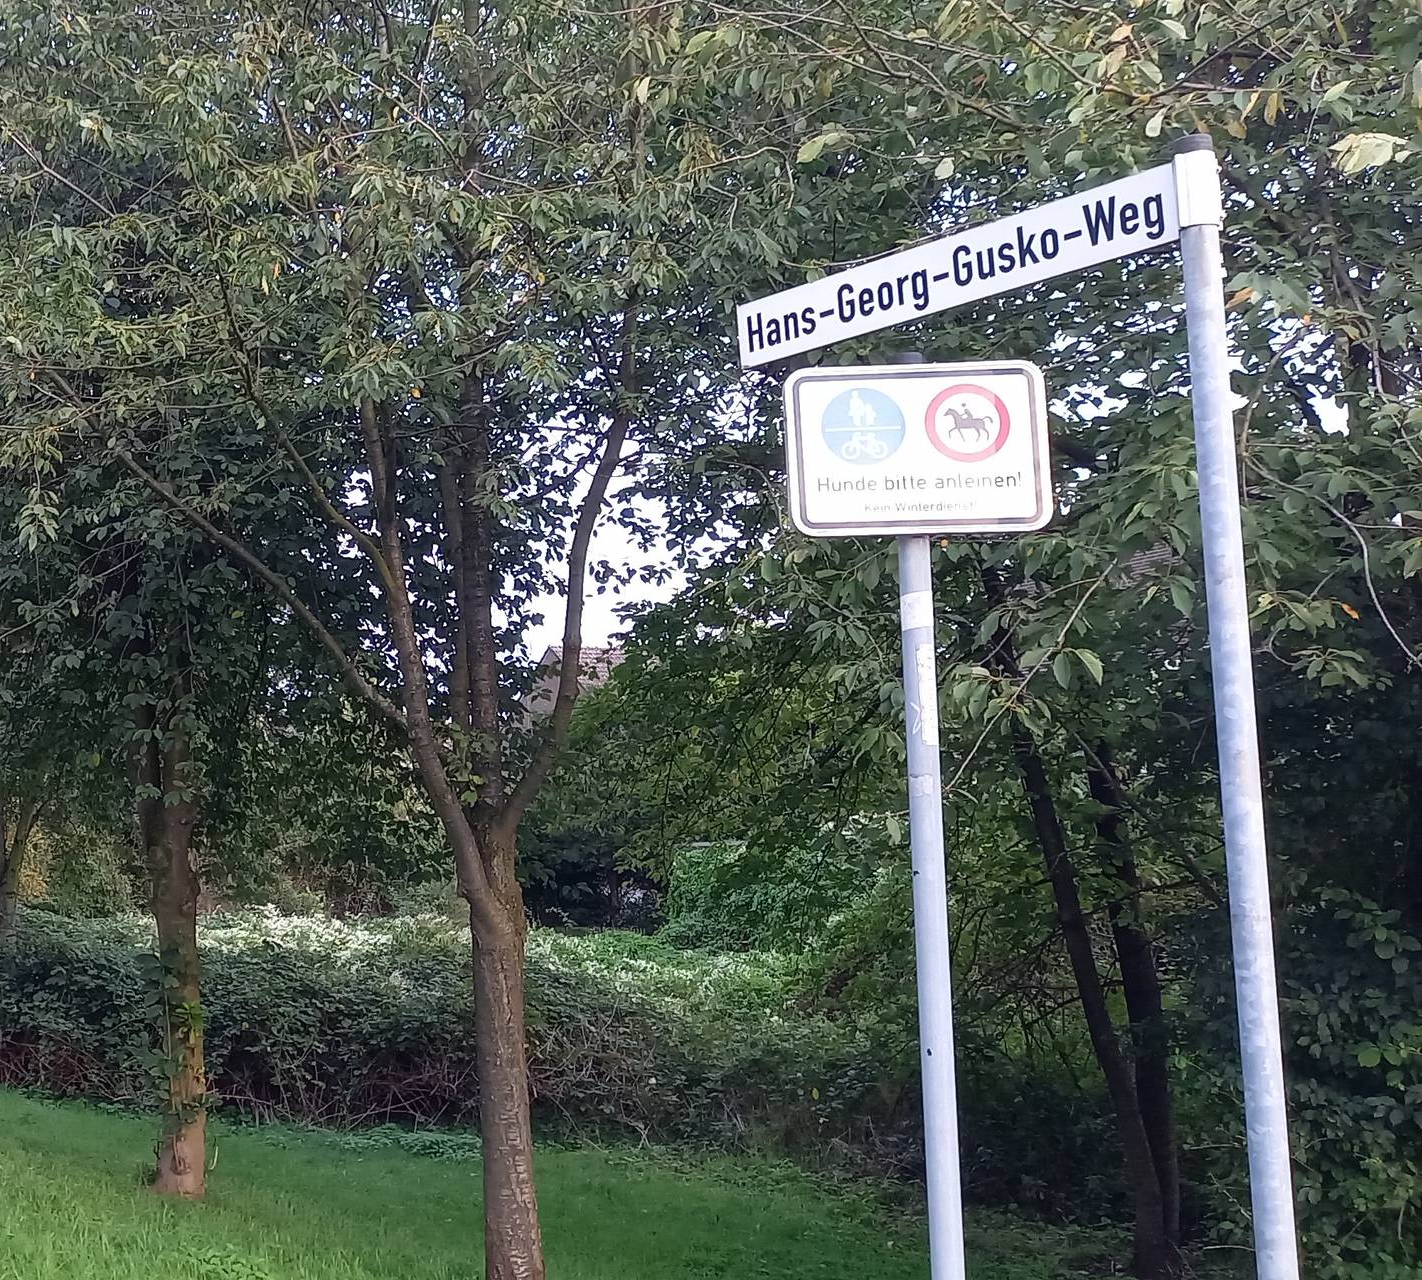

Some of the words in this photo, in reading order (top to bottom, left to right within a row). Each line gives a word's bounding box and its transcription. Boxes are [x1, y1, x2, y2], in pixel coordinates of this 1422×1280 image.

[745, 192, 1166, 353] Hans-Georg-Gusko-Weg
[817, 476, 878, 492] Hunde
[884, 474, 927, 491] bitte
[934, 471, 1022, 490] anleinen!
[864, 502, 891, 513] Kein
